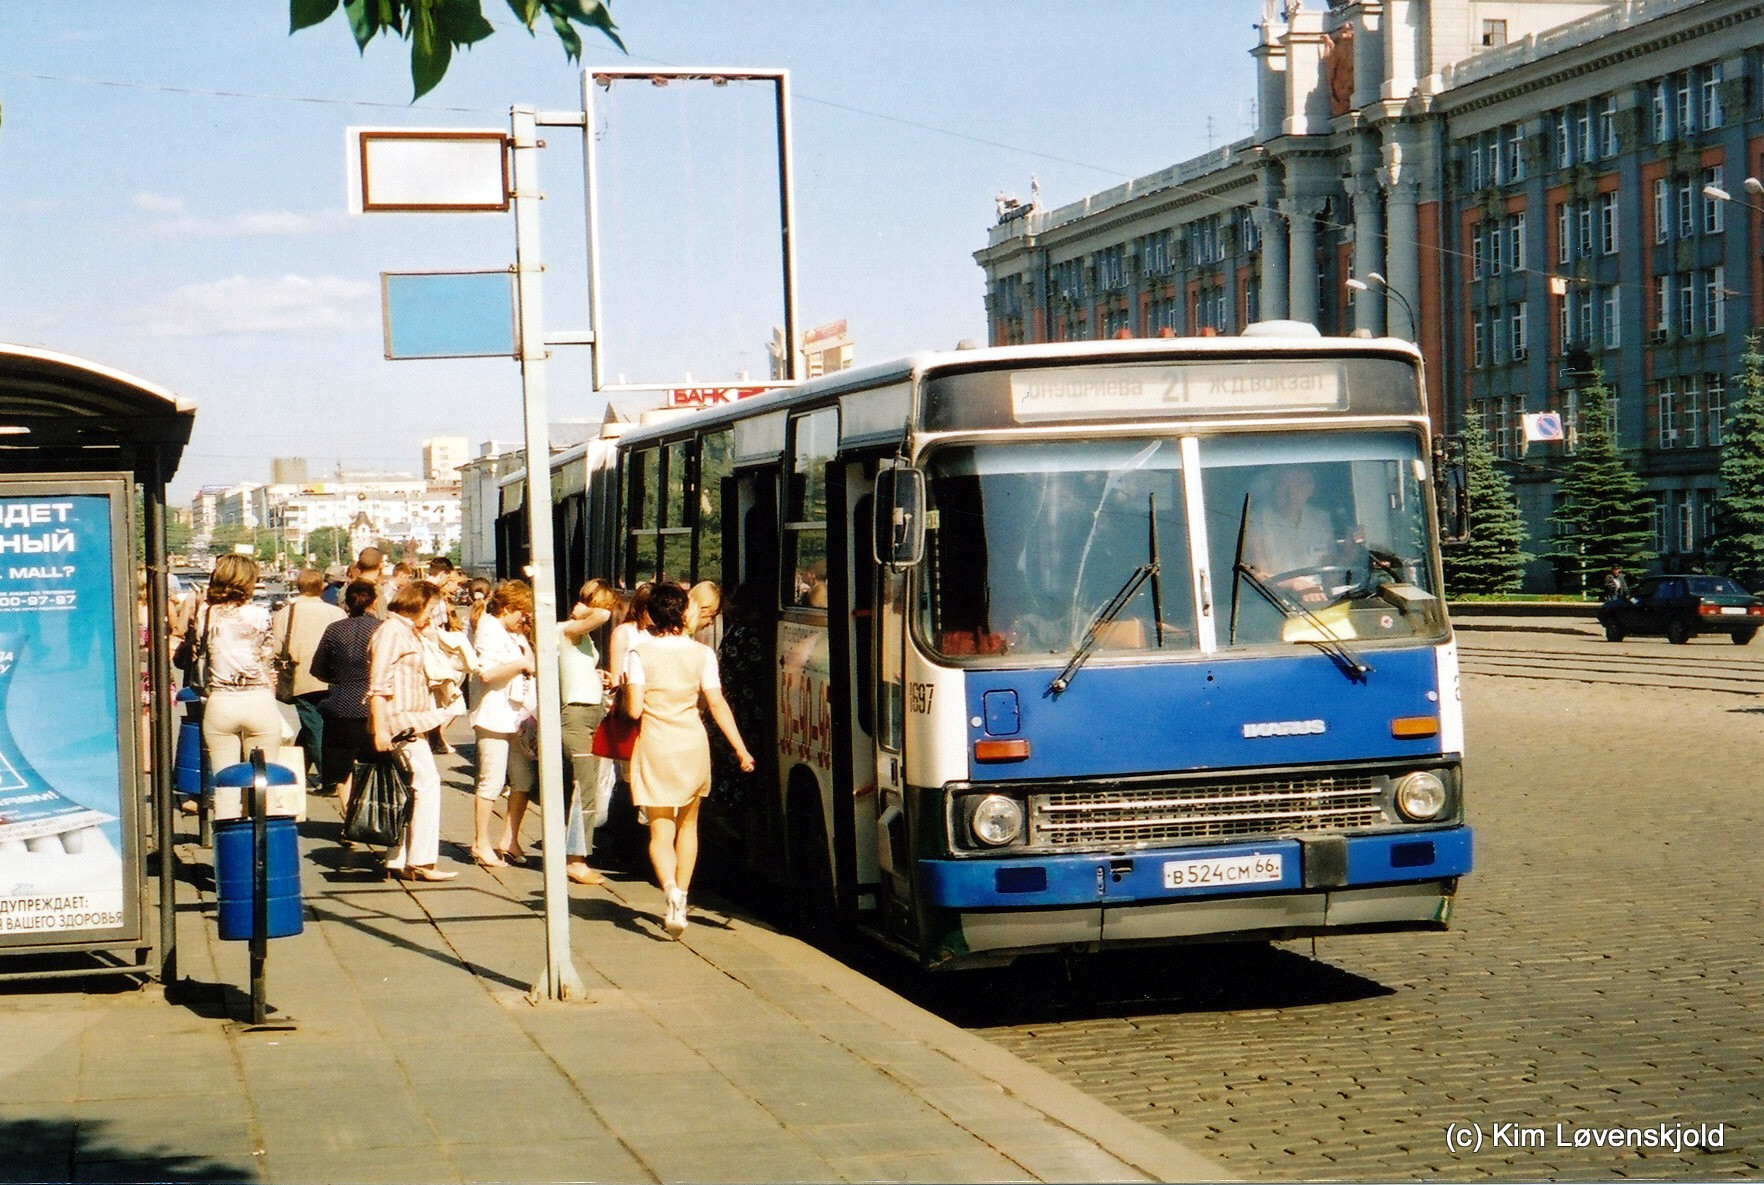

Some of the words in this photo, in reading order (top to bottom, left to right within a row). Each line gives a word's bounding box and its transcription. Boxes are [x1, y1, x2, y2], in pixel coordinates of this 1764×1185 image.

[674, 388, 730, 404] БАНК
[1161, 371, 1190, 403] 21
[0, 503, 74, 528] ДЕТ
[9, 565, 76, 579] MALL?
[909, 682, 934, 714] 1697
[6, 915, 56, 931] ВАШЕГО
[59, 911, 123, 929] ЗДОРОВЬЯ
